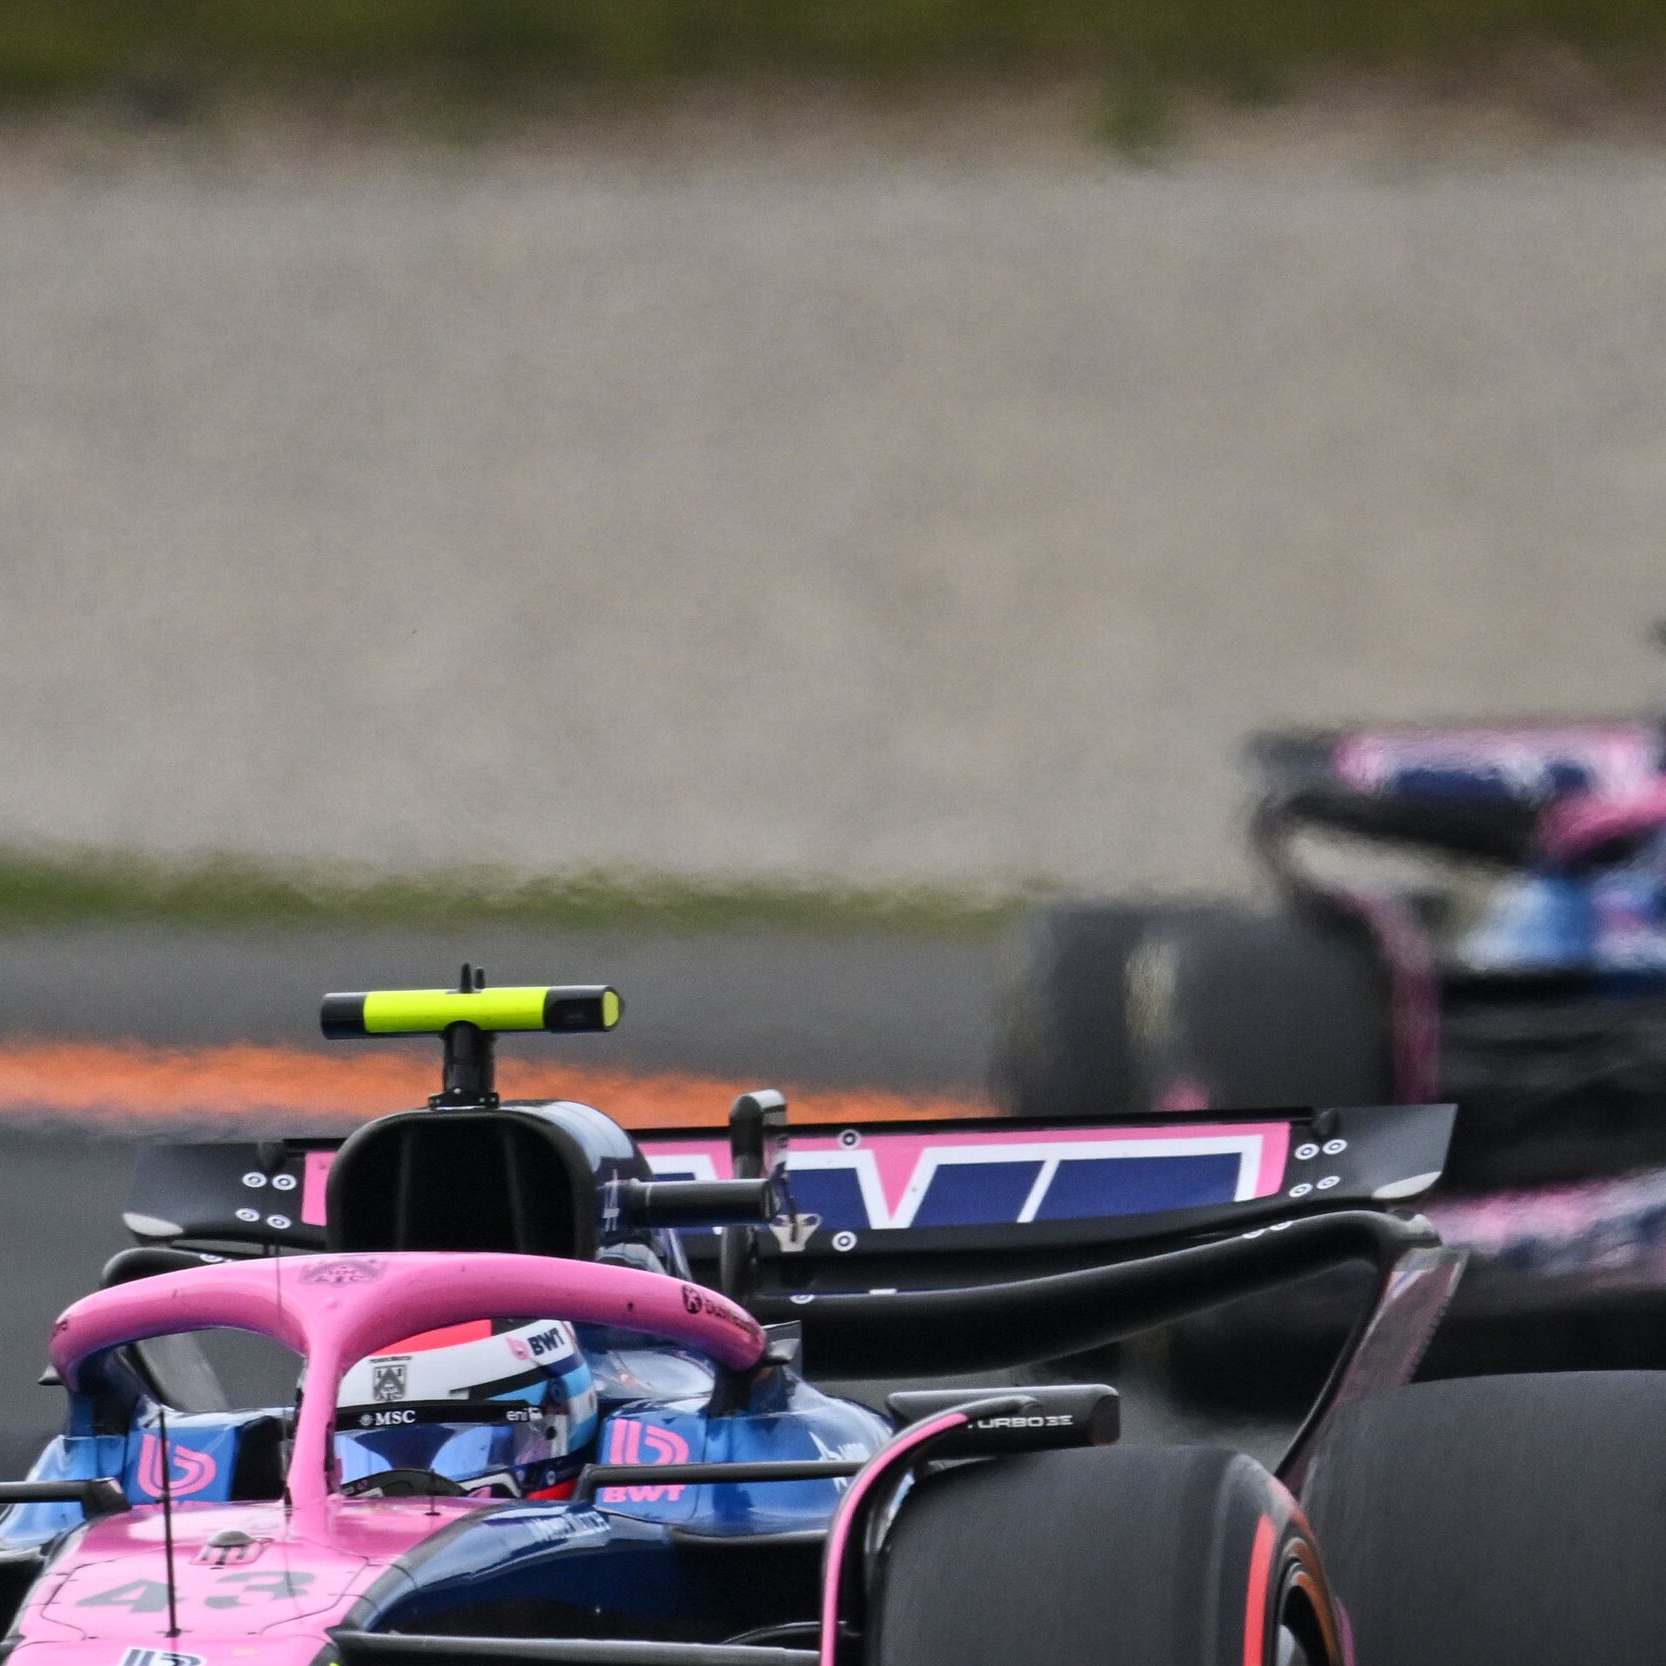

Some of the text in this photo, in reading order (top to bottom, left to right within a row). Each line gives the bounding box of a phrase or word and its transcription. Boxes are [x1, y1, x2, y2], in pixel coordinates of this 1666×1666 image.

[527, 1327, 565, 1357] BWT
[374, 1410, 417, 1426] MSC
[505, 1408, 529, 1422] eni
[602, 1484, 686, 1503] BWT
[76, 1571, 315, 1613] 43
